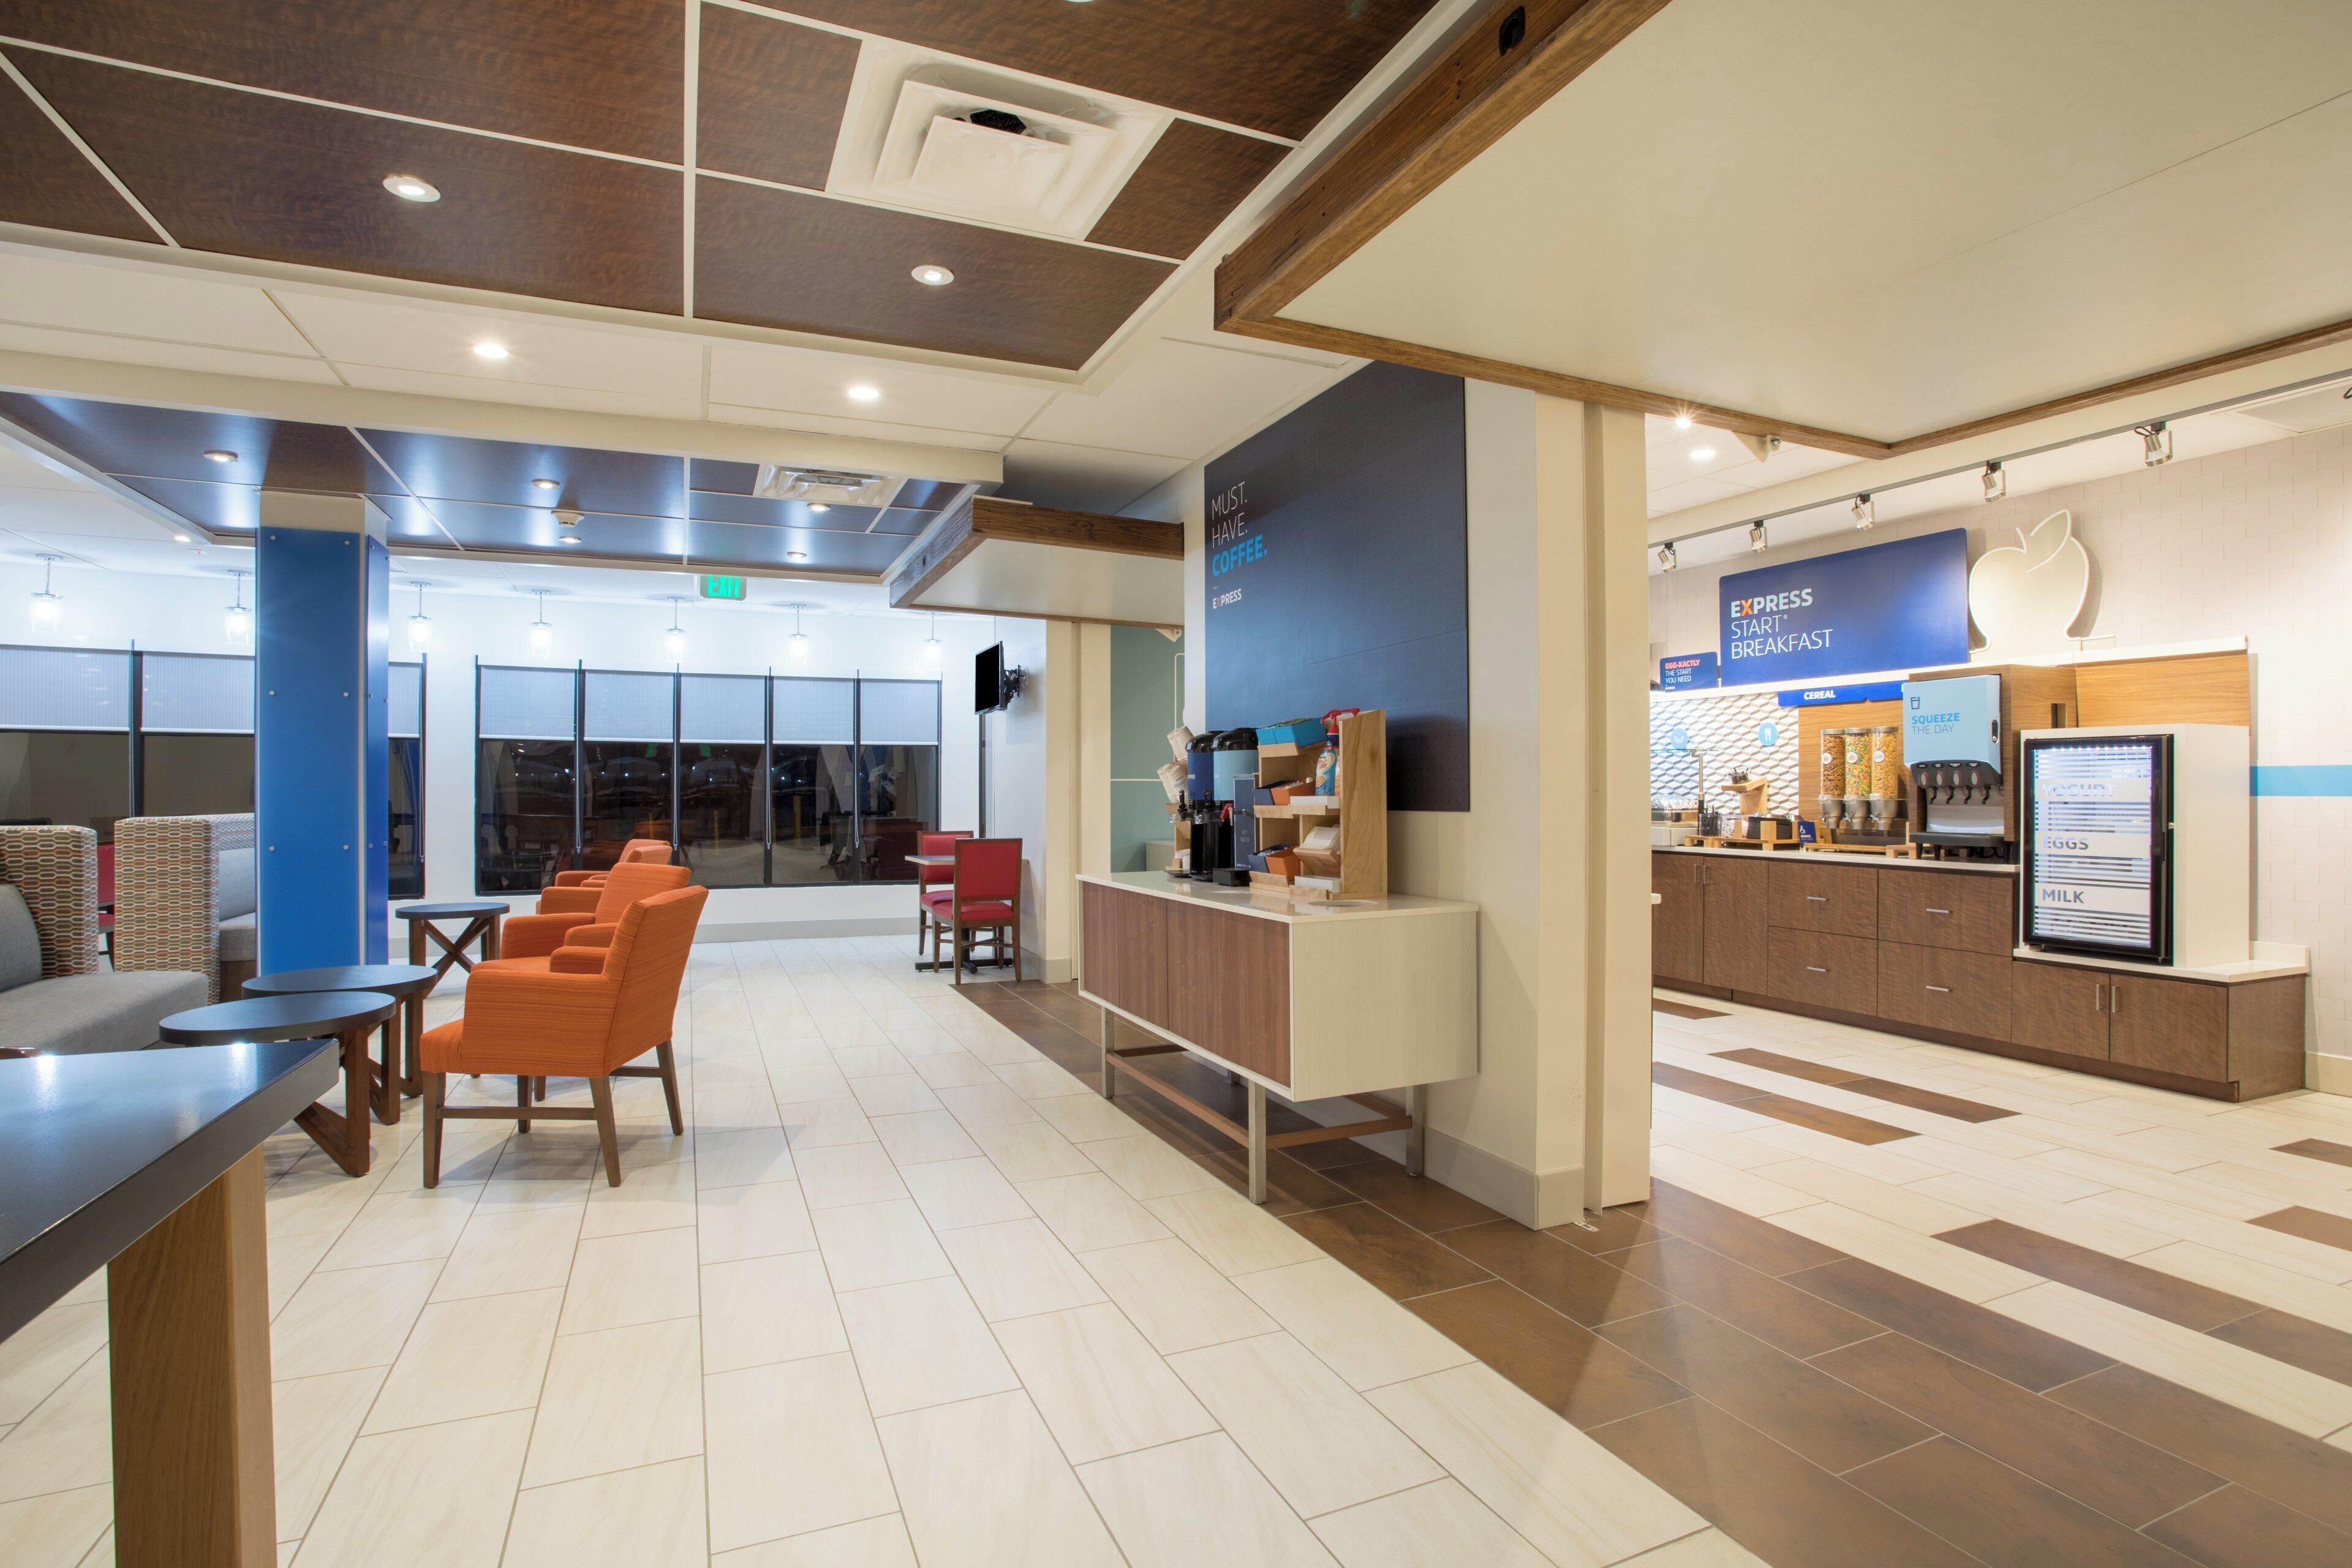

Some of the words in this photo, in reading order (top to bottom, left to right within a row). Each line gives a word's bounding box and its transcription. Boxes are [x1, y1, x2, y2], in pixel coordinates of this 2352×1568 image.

[1212, 481, 1248, 520] MUST.
[1212, 512, 1248, 549] HAVE.
[1212, 534, 1267, 577] COFFEE.
[1213, 588, 1242, 609] EXPRESS
[1731, 588, 1813, 618] EXPRESS
[1731, 629, 1833, 660] BREAKFAST
[1665, 659, 1700, 669] EGG-XACTLY
[1804, 690, 1836, 700] CEREAL
[1911, 712, 1960, 725] SQUEEZE
[1912, 725, 1931, 734] THE
[1934, 724, 1954, 734] DAY
[2041, 783, 2117, 797] YOGURT
[2043, 836, 2089, 850] EGGS
[2042, 889, 2084, 904] MILK
